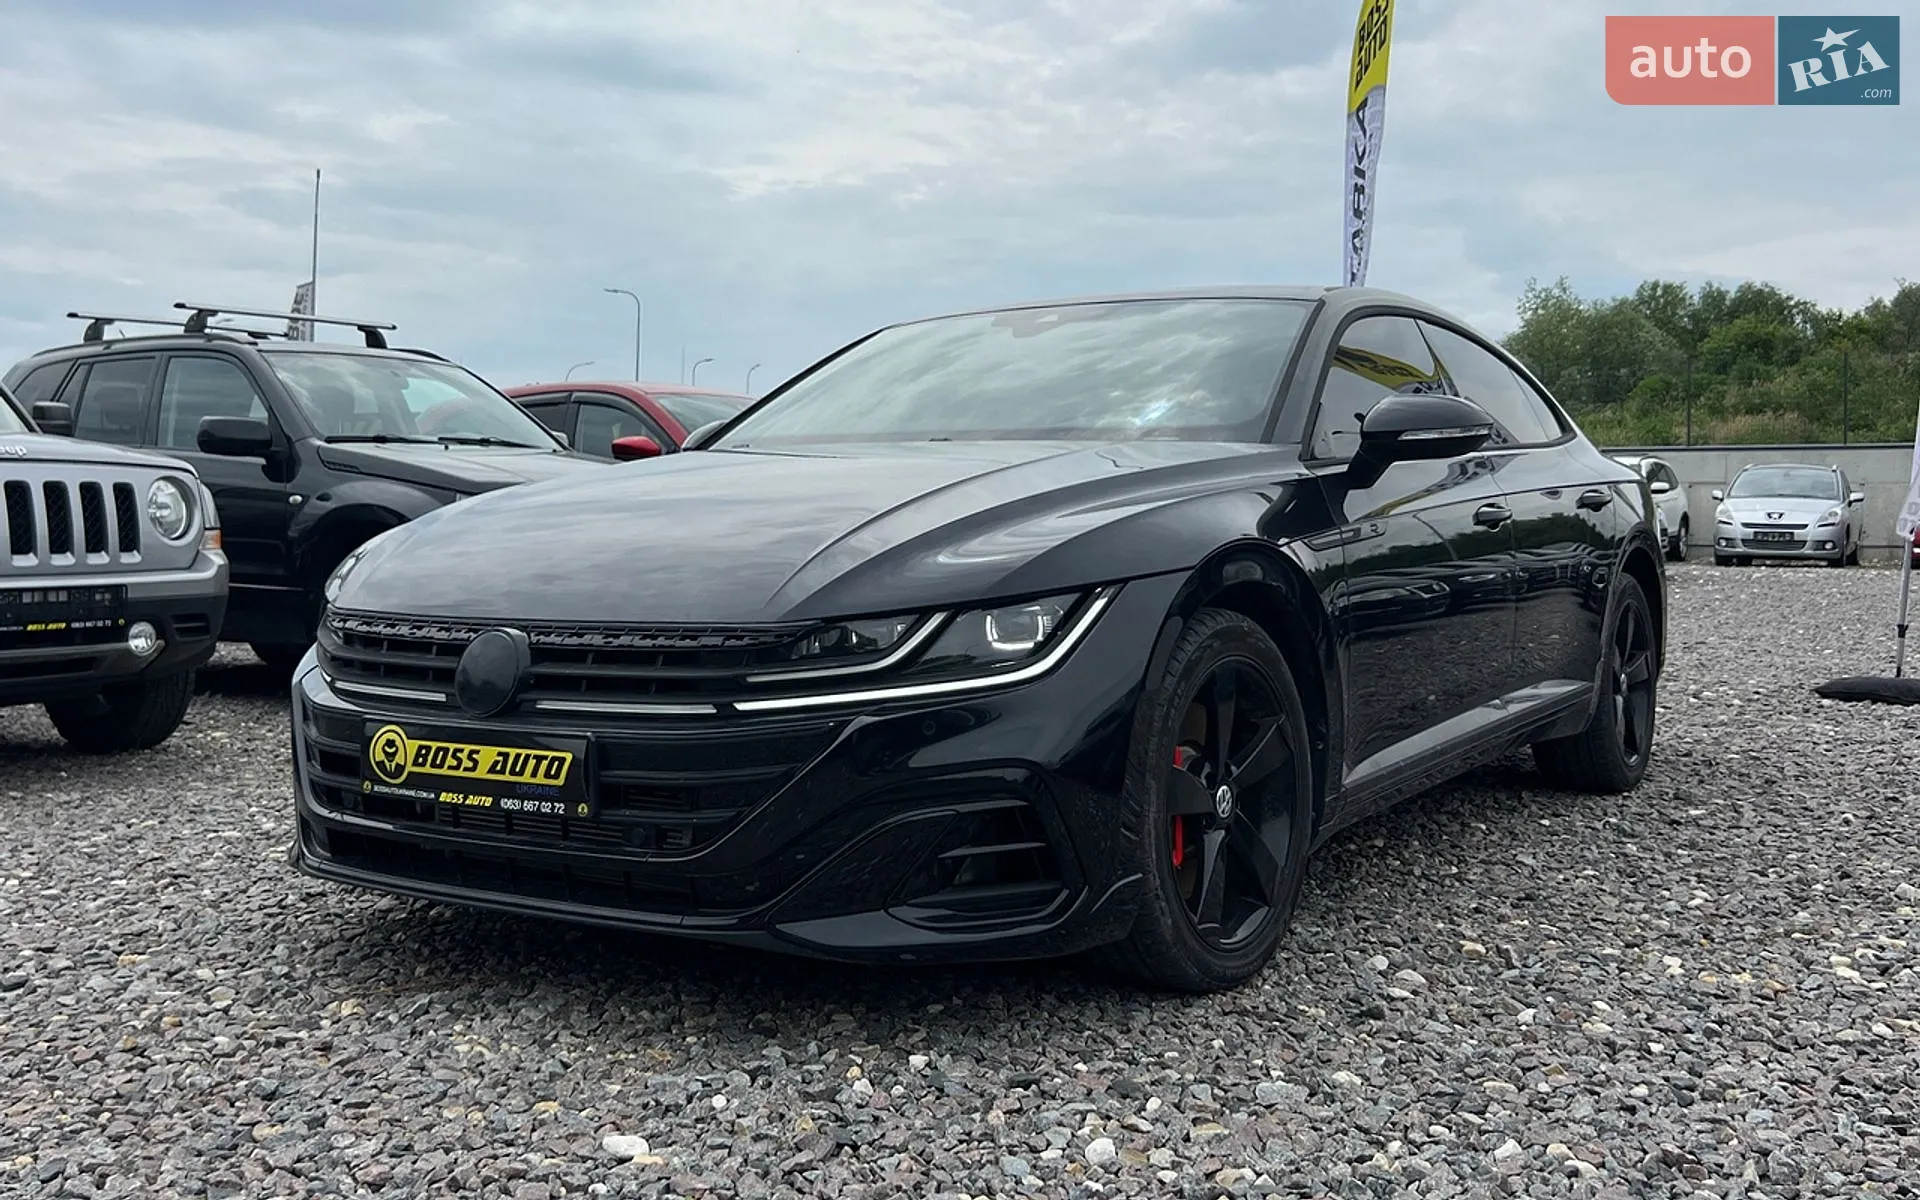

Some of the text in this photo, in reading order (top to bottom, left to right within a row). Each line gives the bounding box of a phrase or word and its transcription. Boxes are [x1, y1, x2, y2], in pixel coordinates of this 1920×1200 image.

[1354, 15, 1387, 92] AUTO
[412, 745, 567, 780] BOSS AUTO
[439, 792, 465, 804] BOSS
[465, 795, 494, 807] AUTO
[500, 797, 521, 810] (063)
[523, 800, 539, 812] 667
[540, 801, 552, 813] 02
[553, 803, 565, 815] 72
